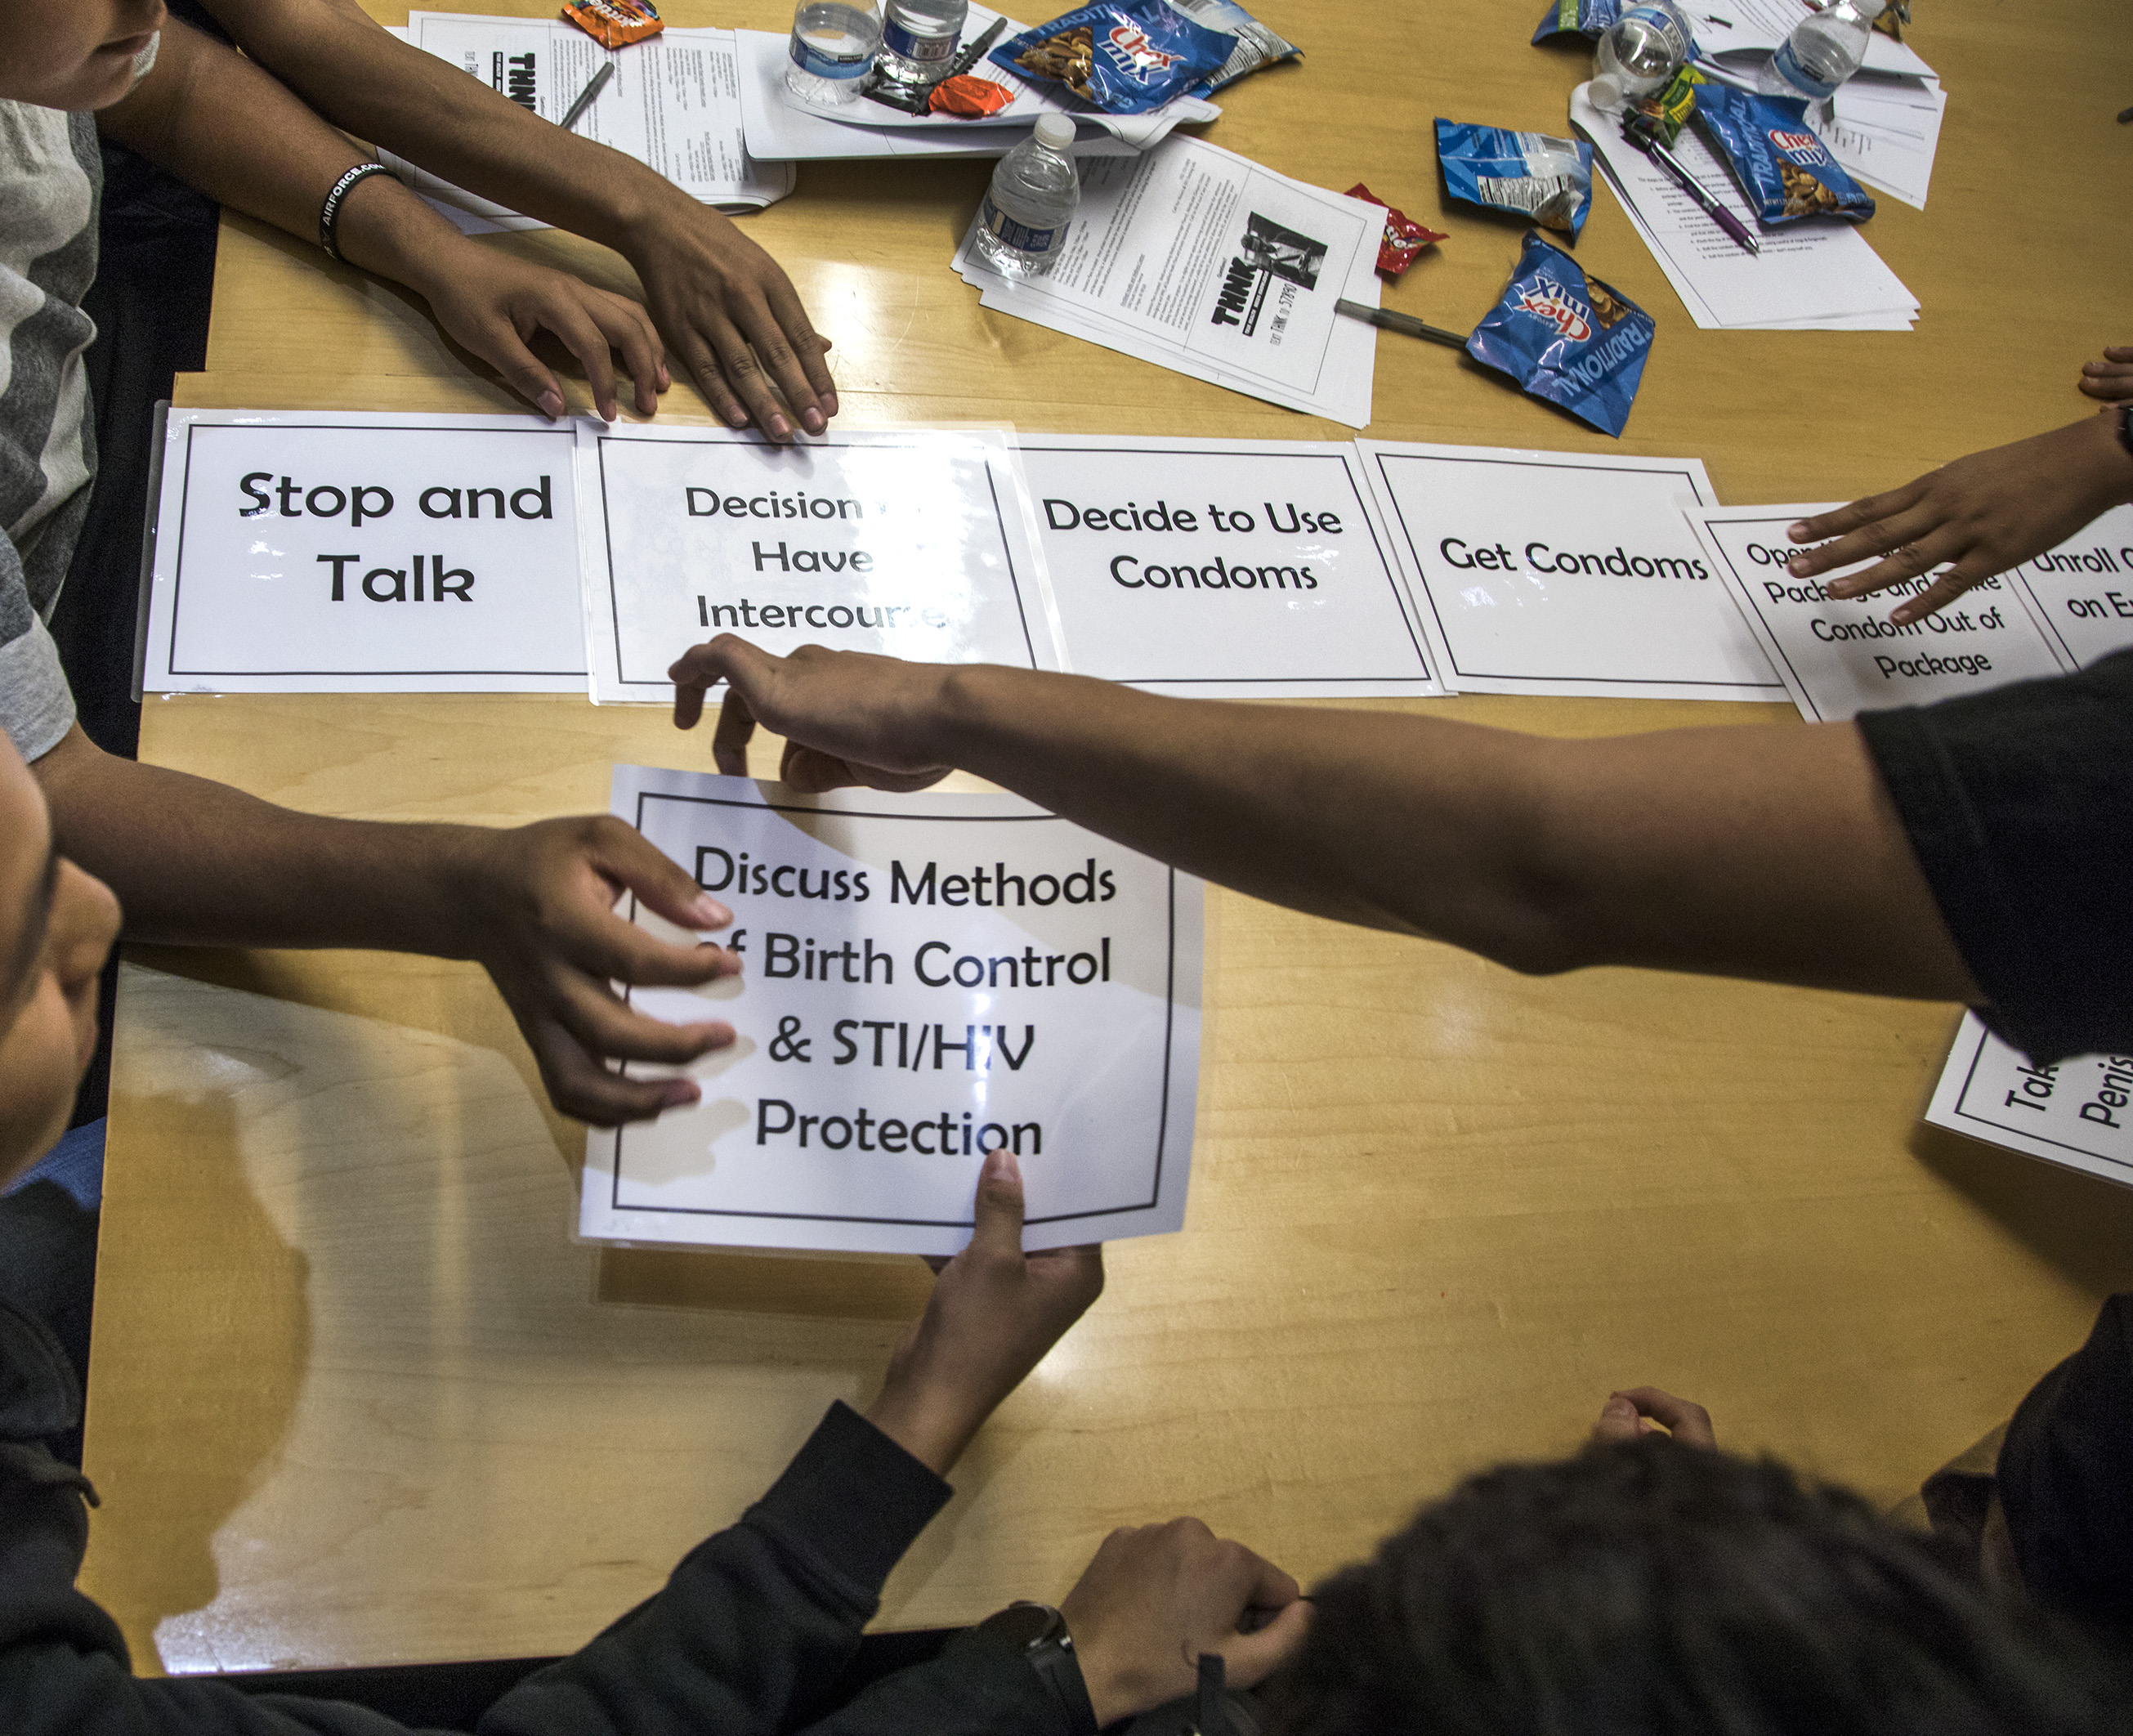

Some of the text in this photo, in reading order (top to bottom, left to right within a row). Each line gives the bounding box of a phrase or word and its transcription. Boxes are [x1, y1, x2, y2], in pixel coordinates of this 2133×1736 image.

[508, 52, 535, 110] THN
[1210, 256, 1259, 326] THNK
[1279, 282, 1298, 307] 57890
[1514, 298, 1592, 342] Chex
[239, 472, 553, 527] Stop and
[685, 486, 864, 520] Decision
[1042, 498, 1344, 535] Decide to Use
[315, 554, 475, 602] Talk
[750, 541, 874, 573] Have
[1110, 554, 1318, 590] Condoms
[1439, 537, 1709, 580] Get Condoms
[2032, 547, 2121, 574] Unroll
[696, 594, 946, 629] Intercoure
[1924, 611, 1977, 633] Out
[1979, 606, 2006, 629] of
[2067, 598, 2108, 618] on
[1873, 651, 1992, 679] Package
[695, 845, 1116, 906] Discuss Methods
[764, 932, 894, 984] Birth
[914, 936, 1111, 988] Control
[768, 1015, 1035, 1072] & STI/HIV
[2005, 1065, 2059, 1112] Tak
[756, 1098, 1042, 1157] Protection
